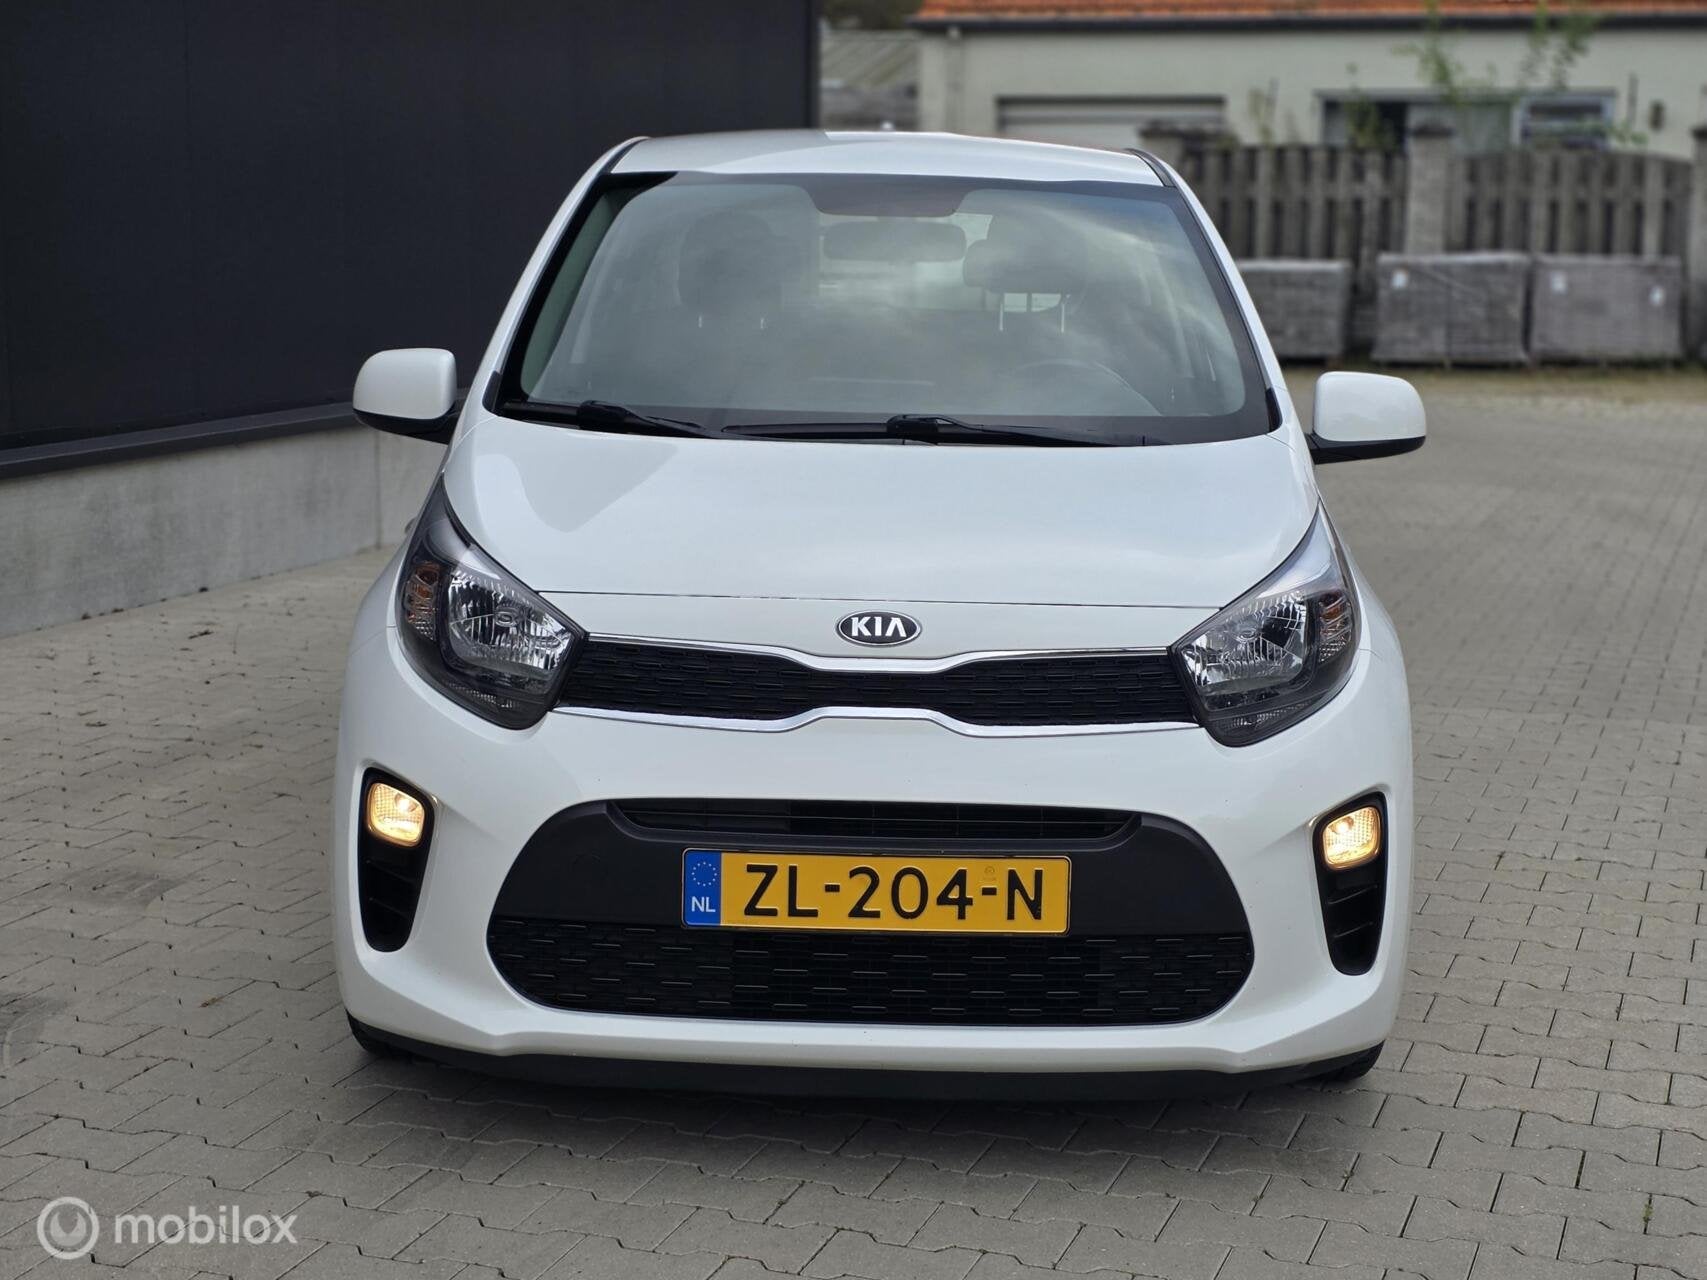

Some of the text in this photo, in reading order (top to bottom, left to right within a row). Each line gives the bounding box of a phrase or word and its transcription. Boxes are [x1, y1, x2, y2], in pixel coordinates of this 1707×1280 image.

[851, 616, 907, 637] KIA
[743, 863, 1044, 920] ZL-204-N
[691, 896, 716, 913] NL
